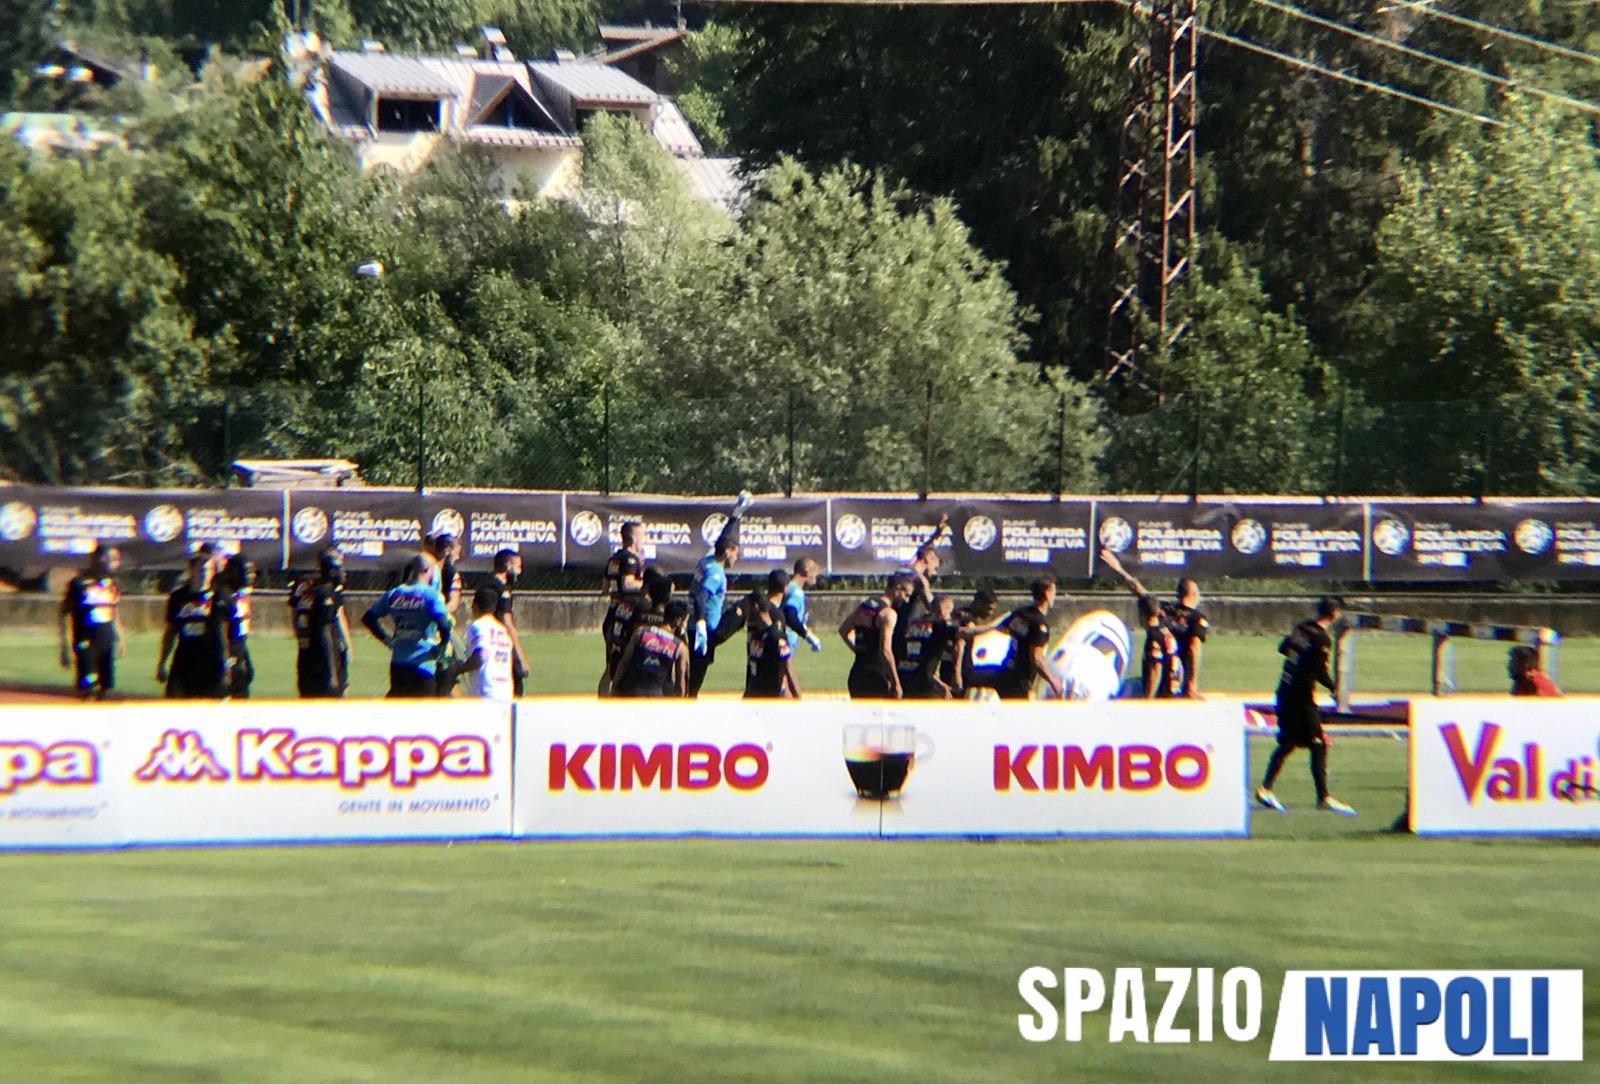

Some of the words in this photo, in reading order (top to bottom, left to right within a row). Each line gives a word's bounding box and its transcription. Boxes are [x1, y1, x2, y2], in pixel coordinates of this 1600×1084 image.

[236, 728, 493, 788] Kappa
[548, 743, 770, 791] KIMBO
[993, 743, 1211, 791] KIMBO
[1438, 721, 1541, 807] Val
[338, 799, 382, 814] GENTE
[387, 799, 403, 813] IN
[407, 797, 491, 814] MOVIMENTO
